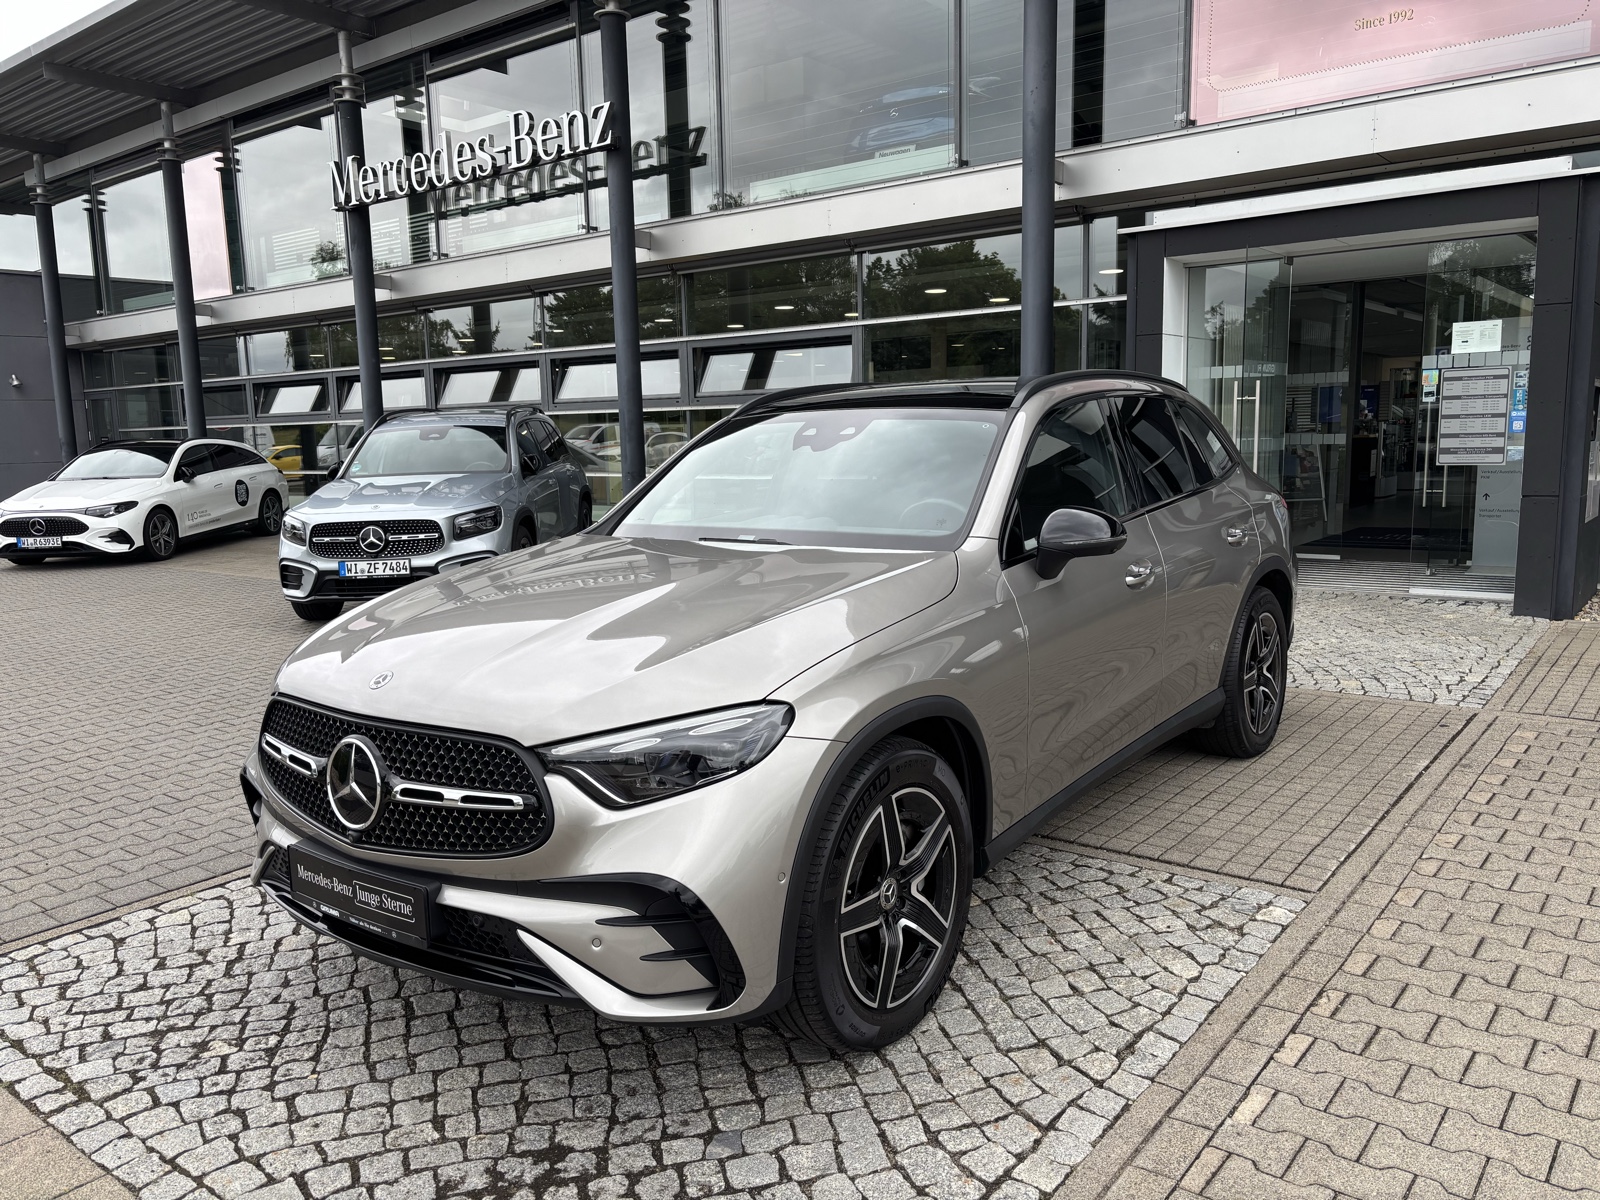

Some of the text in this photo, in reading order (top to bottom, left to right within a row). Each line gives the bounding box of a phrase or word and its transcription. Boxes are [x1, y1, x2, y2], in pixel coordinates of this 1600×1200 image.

[1354, 8, 1414, 31] Since 1992
[329, 100, 614, 211] Mercedes-Benz
[878, 148, 911, 158] Neuwagen
[346, 563, 359, 575] WI
[382, 561, 408, 574] 7484
[839, 770, 890, 855] MICHELIN
[297, 864, 412, 916] Mercedes-Benz Junge Sterne
[849, 1022, 866, 1037] OUTSIDE
